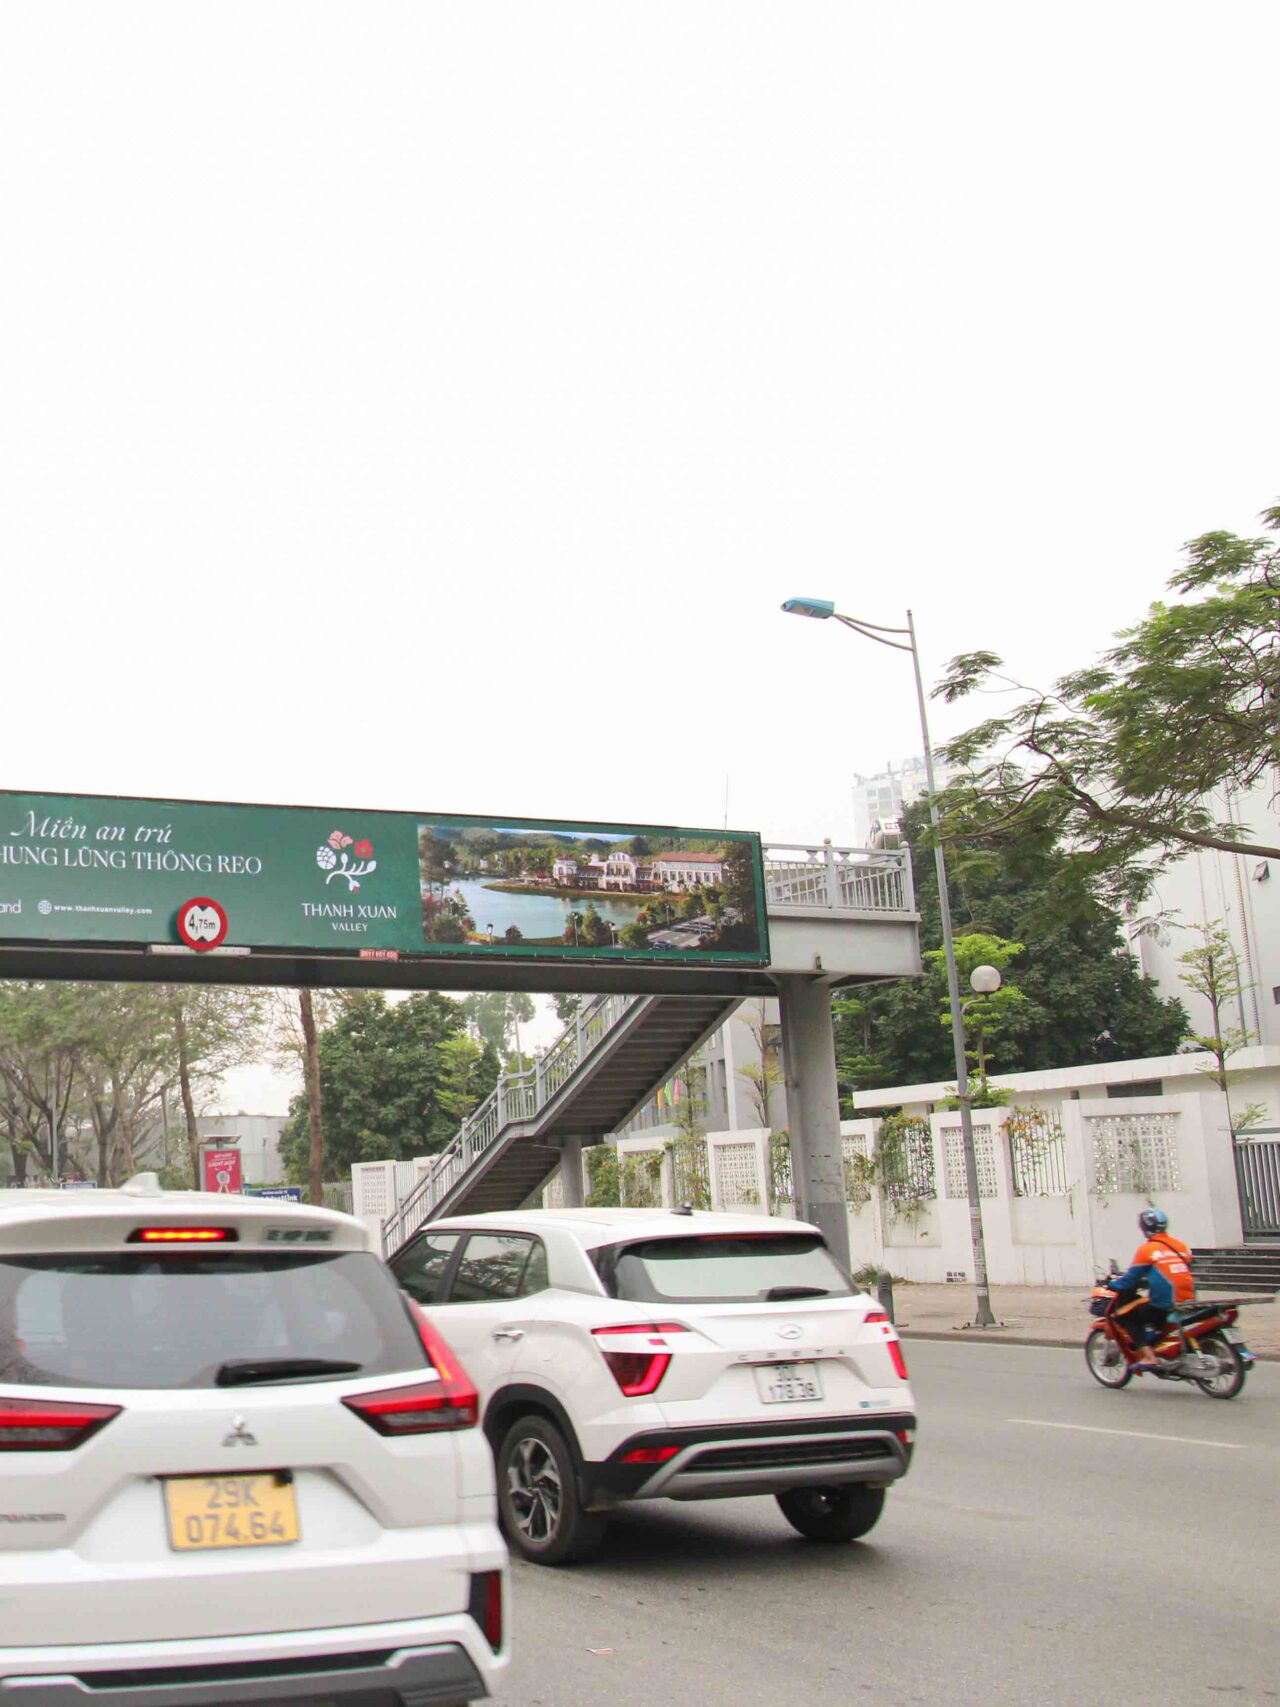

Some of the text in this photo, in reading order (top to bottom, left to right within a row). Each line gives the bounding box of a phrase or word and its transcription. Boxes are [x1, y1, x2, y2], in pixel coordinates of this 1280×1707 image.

[10, 810, 172, 843] Miền an trú
[64, 847, 126, 869] LŨNG
[132, 850, 212, 873] THÔNG
[218, 855, 262, 874] REO
[301, 903, 397, 919] THANH XUAN
[189, 913, 216, 933] 4,75m
[332, 923, 368, 932] VALLEY
[738, 1350, 844, 1360] CRETA
[205, 1479, 260, 1508] 29K
[185, 1510, 285, 1543] 074.64
